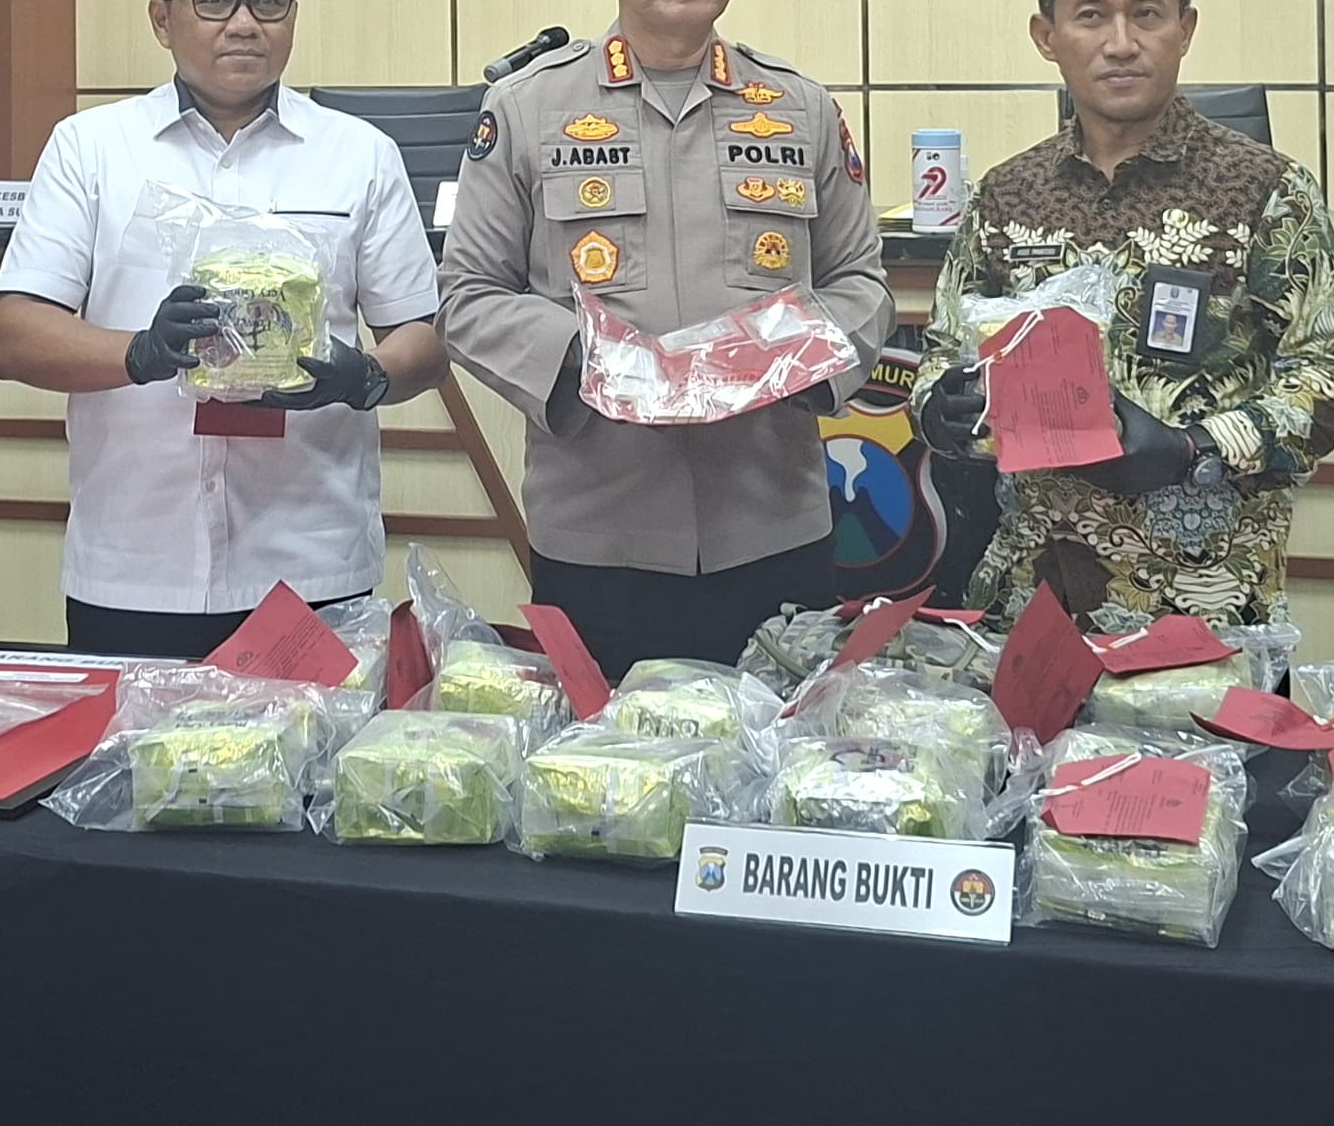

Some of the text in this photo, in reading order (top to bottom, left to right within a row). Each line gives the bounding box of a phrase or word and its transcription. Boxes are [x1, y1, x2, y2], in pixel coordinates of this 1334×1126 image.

[552, 147, 631, 166] J.ABAST
[728, 145, 805, 166] POLRI
[742, 852, 934, 910] BARANG BUKTI
